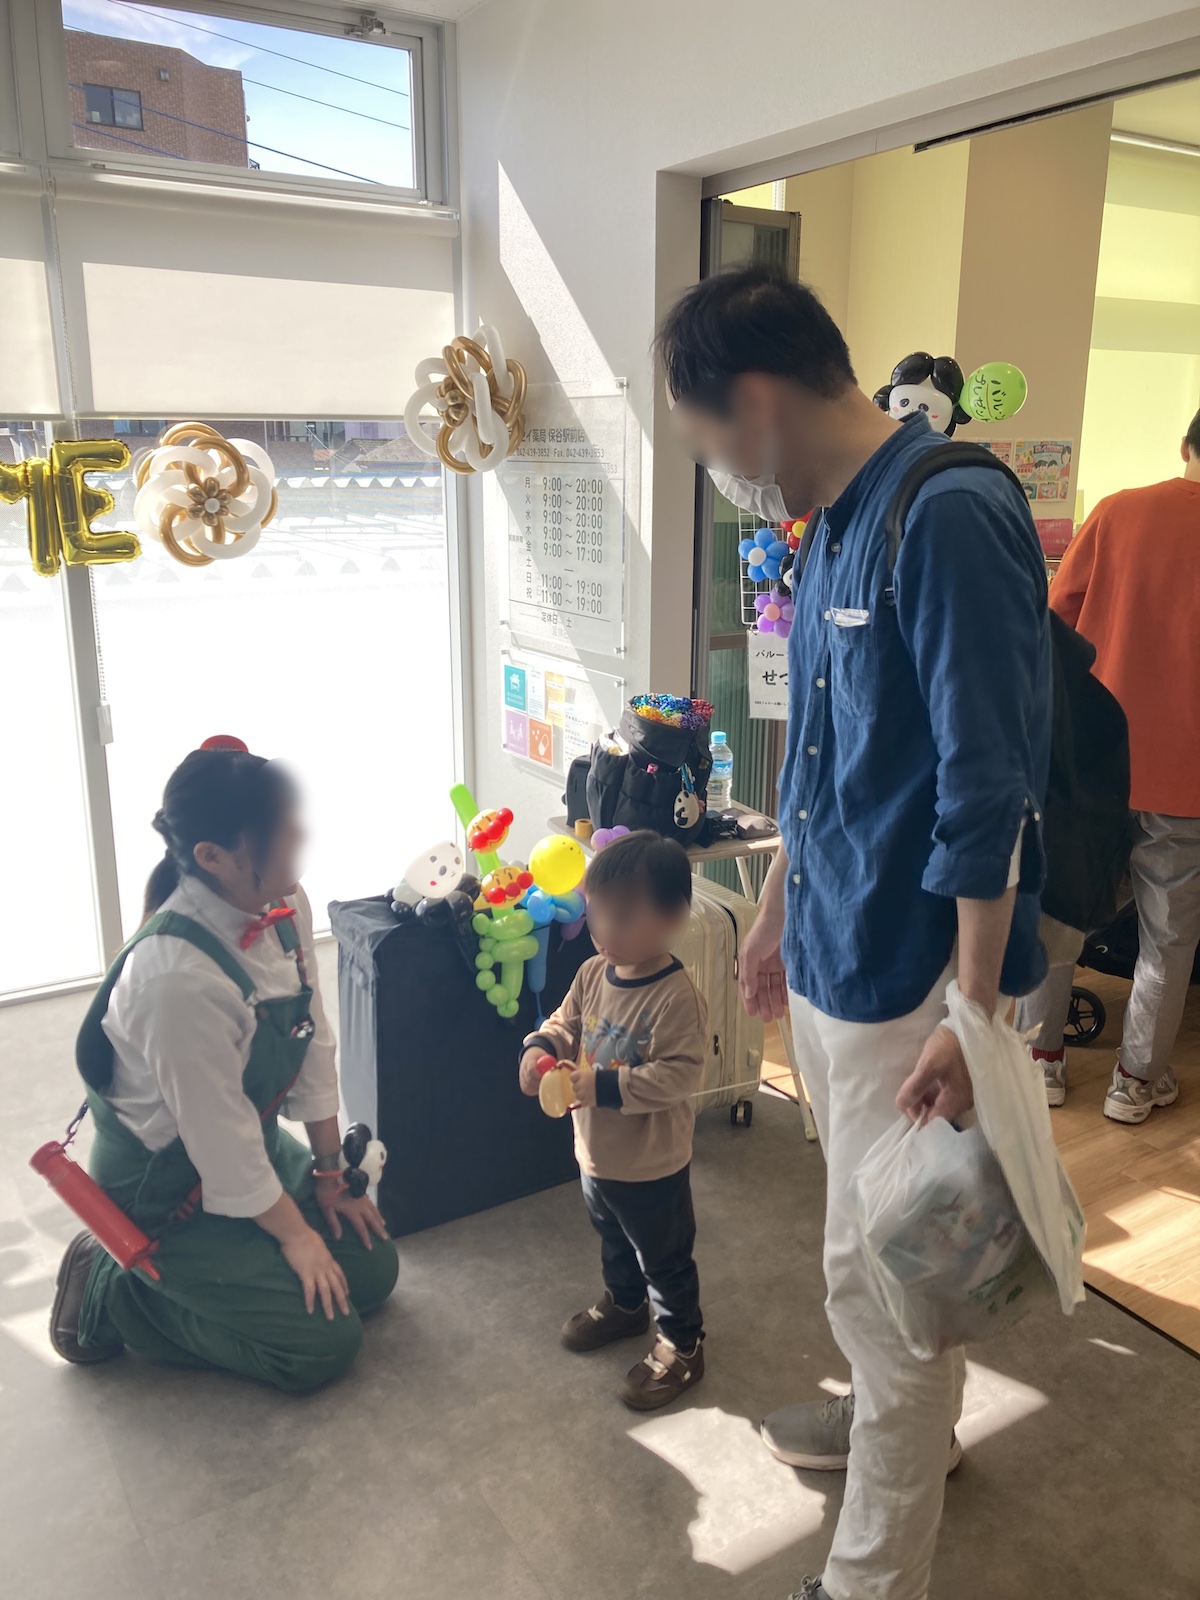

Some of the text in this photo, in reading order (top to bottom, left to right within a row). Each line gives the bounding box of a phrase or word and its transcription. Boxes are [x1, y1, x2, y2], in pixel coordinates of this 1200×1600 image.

[525, 477, 531, 489] 月
[542, 477, 562, 491] 9:00
[576, 478, 603, 494] 20:00
[542, 493, 562, 508] 9:00
[576, 496, 603, 512] 20:00
[543, 510, 562, 525] 9:00
[576, 513, 603, 529] 20:00
[543, 526, 562, 541] 9:00
[576, 530, 603, 546] 20:00
[543, 542, 562, 558] 9:00
[577, 547, 602, 563] 17:00
[526, 571, 532, 583] 日
[541, 574, 562, 590] 11:00
[577, 580, 602, 597] 19:00
[541, 590, 562, 606] 11:00
[577, 596, 602, 614] 19:00
[755, 649, 788, 659] バルー
